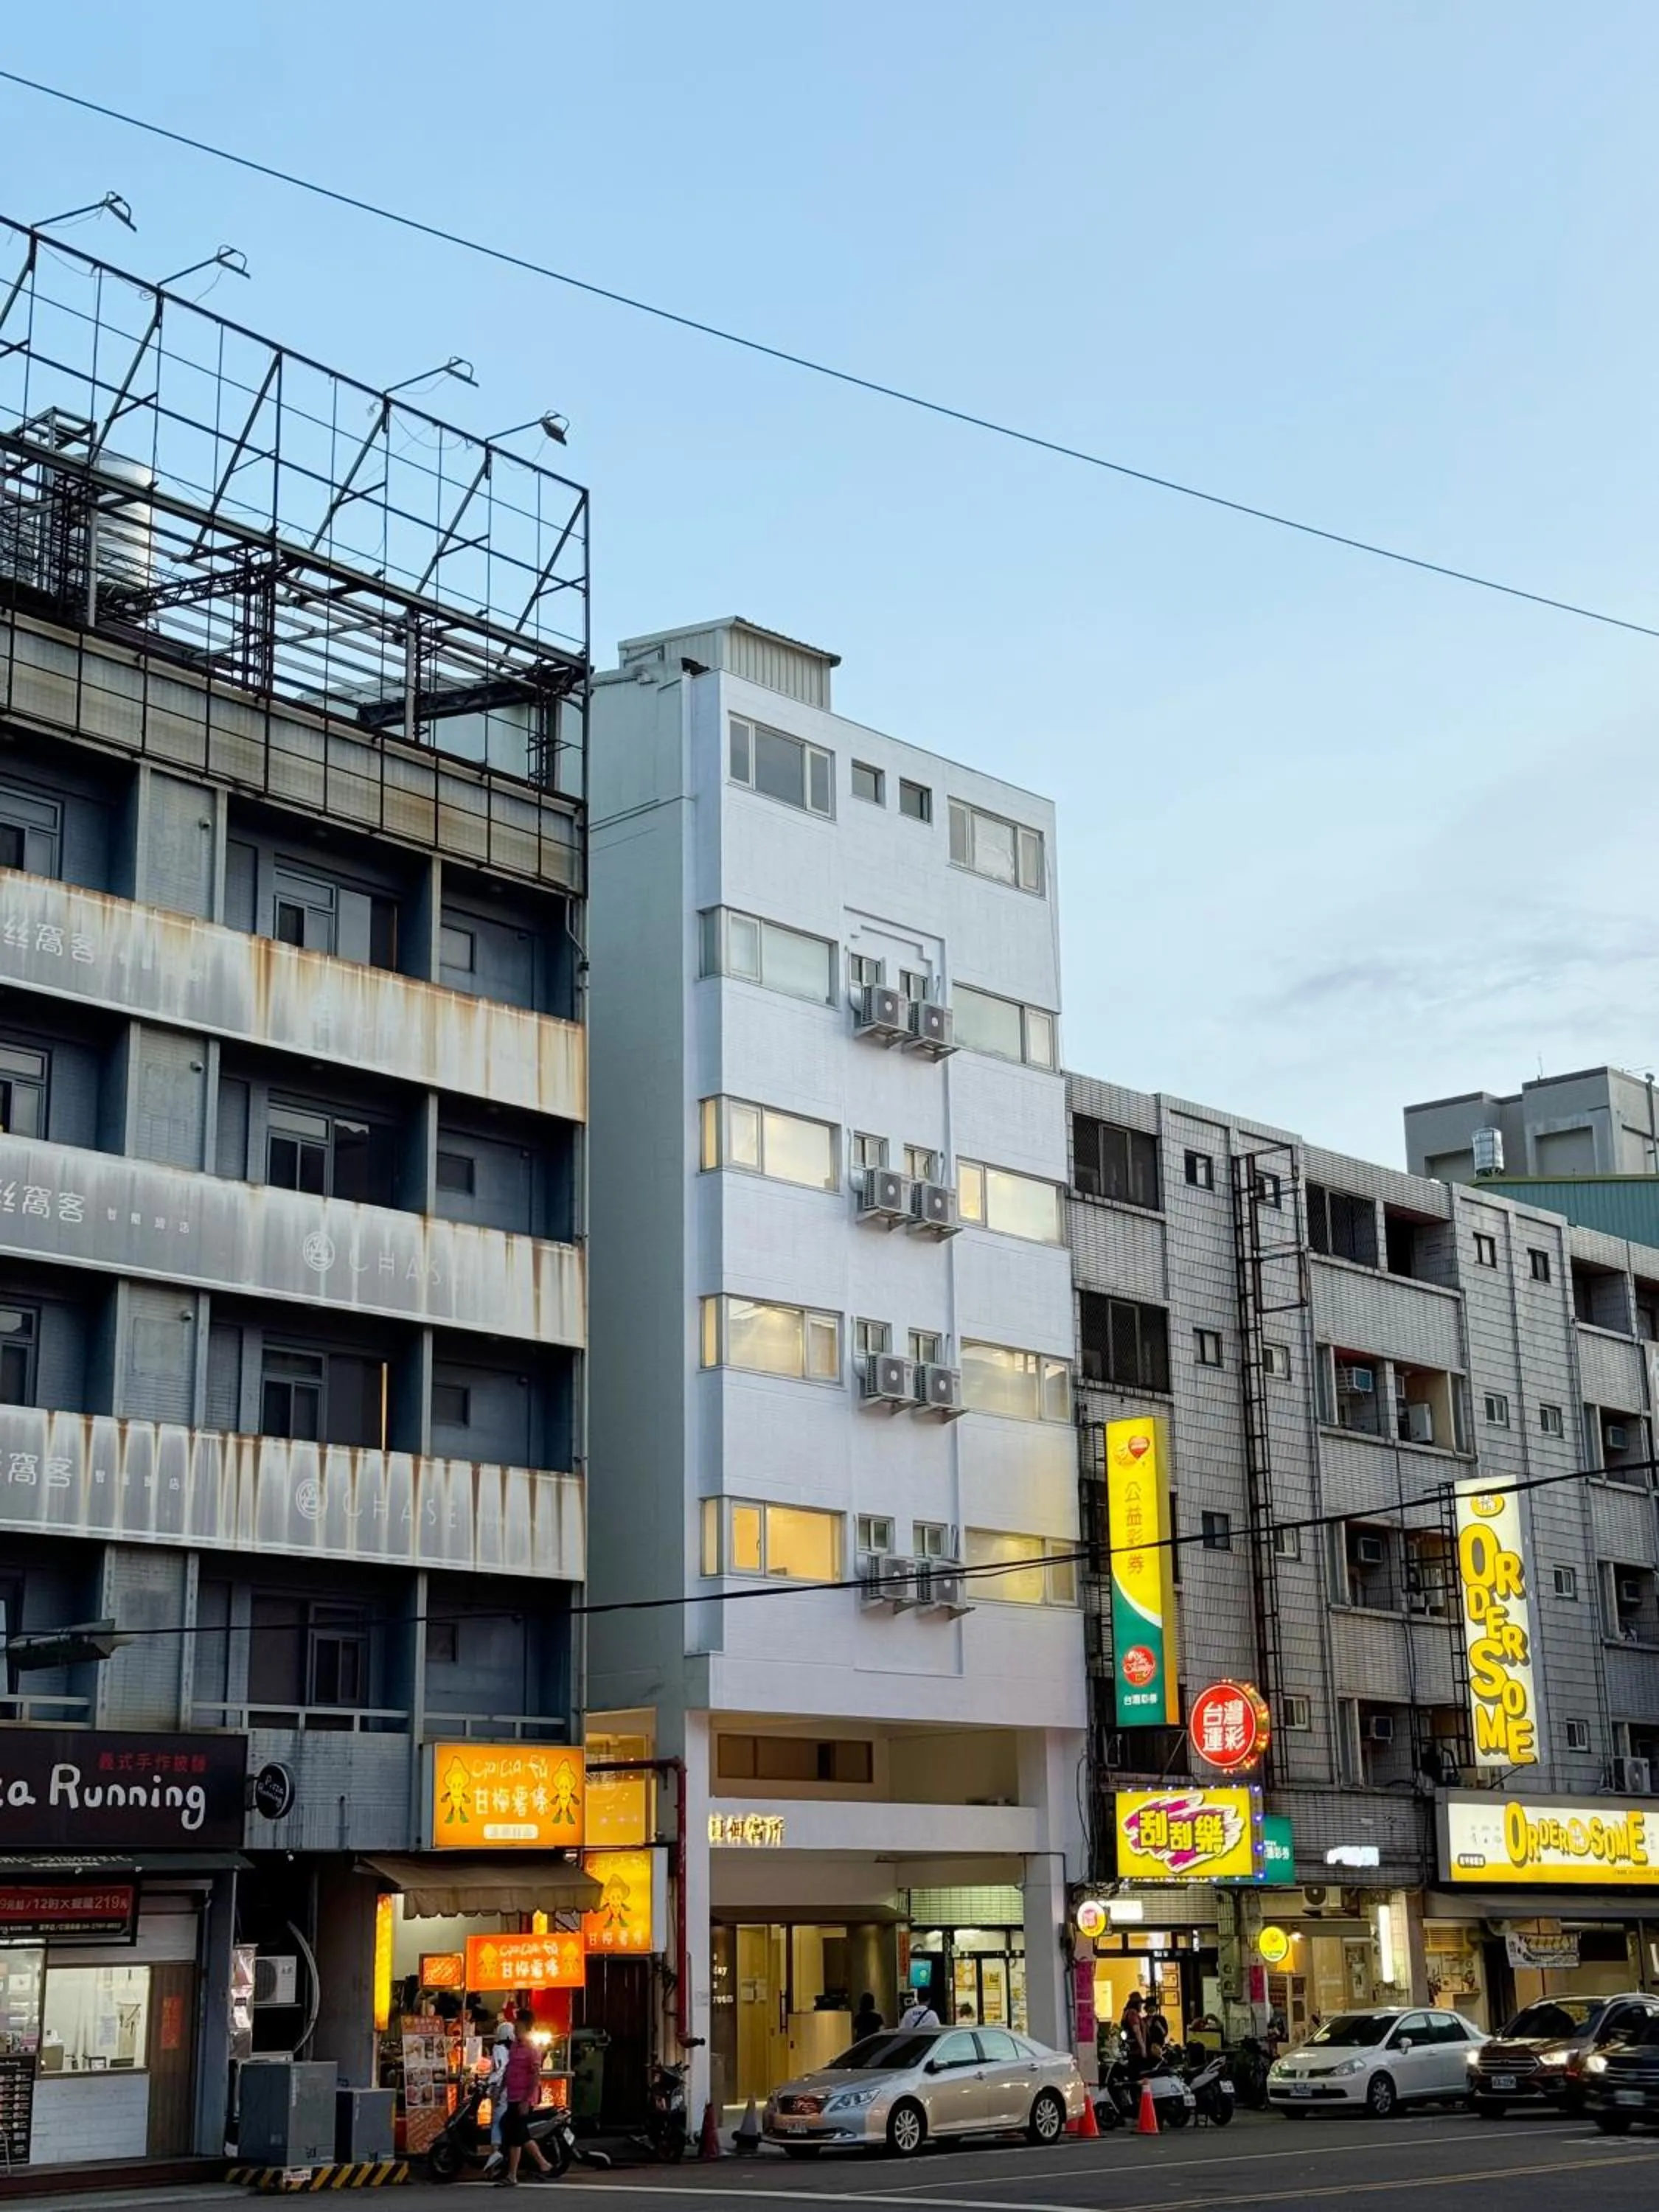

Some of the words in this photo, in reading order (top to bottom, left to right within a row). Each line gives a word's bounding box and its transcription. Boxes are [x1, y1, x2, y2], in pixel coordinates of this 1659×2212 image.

[349, 1250, 460, 1289] CHAS
[1124, 1480, 1145, 1576] 公益彩券
[1458, 1523, 1526, 1669] ORDER
[1203, 1700, 1244, 1726] 台灣
[1469, 1638, 1537, 1764] SOME
[1203, 1727, 1246, 1752] 運彩
[0, 1778, 36, 1806] a
[49, 1763, 206, 1831] Running
[1139, 1809, 1224, 1854] 刮刮樂
[1504, 1801, 1571, 1868] ORDER
[1589, 1809, 1649, 1865] SOME
